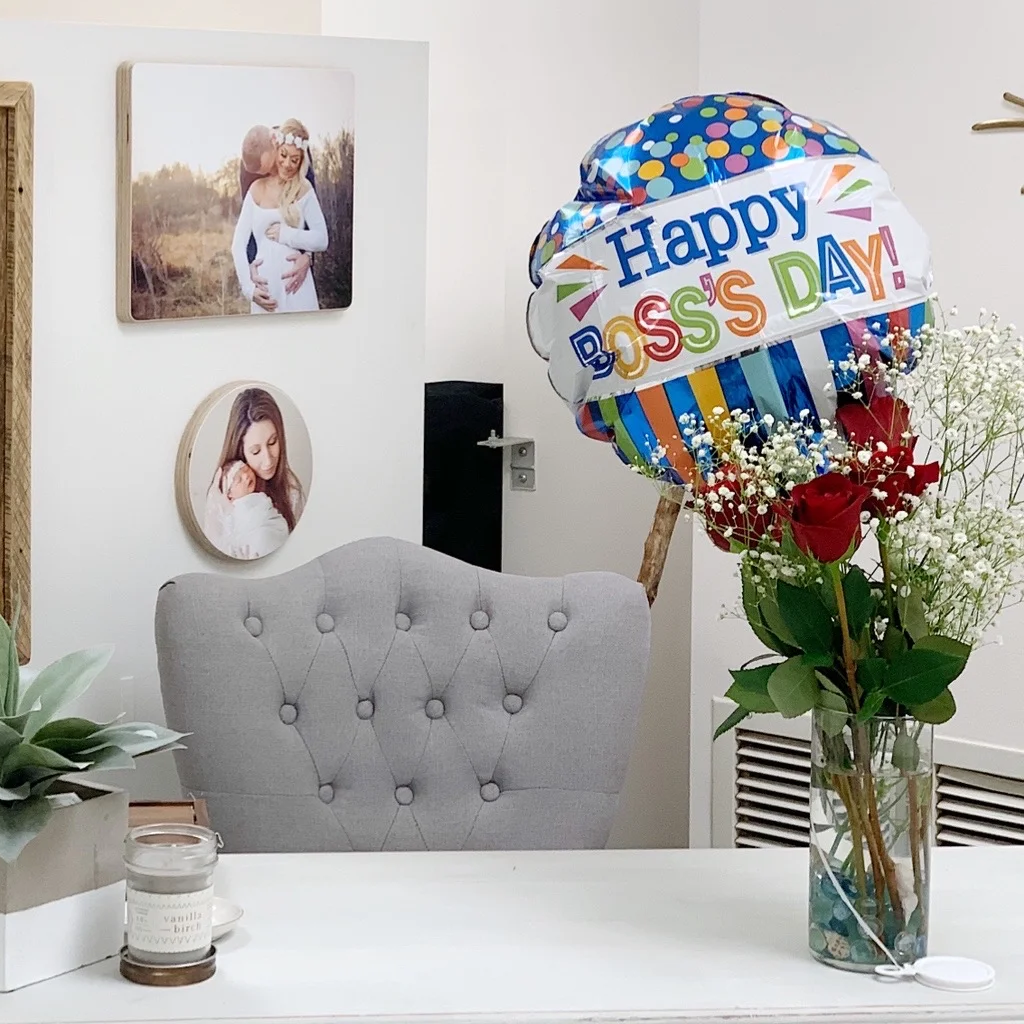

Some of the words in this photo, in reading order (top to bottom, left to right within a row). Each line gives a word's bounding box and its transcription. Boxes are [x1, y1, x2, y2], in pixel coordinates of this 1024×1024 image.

[606, 182, 808, 288] Happy
[569, 270, 768, 381] BOSS'S
[769, 225, 906, 320] DAY!
[163, 911, 203, 924] vanilla
